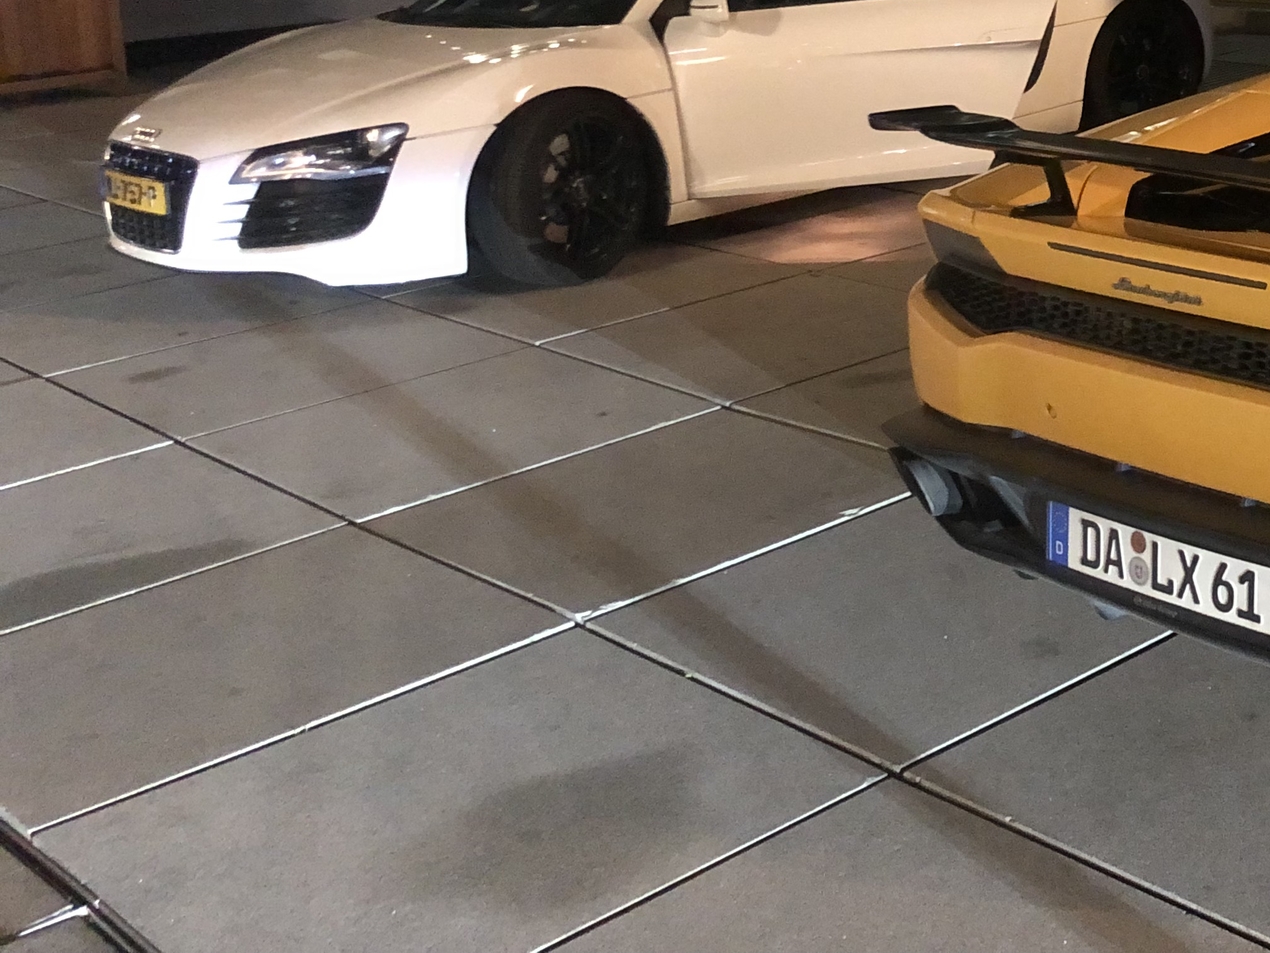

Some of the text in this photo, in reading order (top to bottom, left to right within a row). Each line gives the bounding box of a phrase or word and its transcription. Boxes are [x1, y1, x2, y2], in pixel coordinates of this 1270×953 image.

[1055, 540, 1064, 555] D
[1080, 518, 1261, 624] DA LX 61
